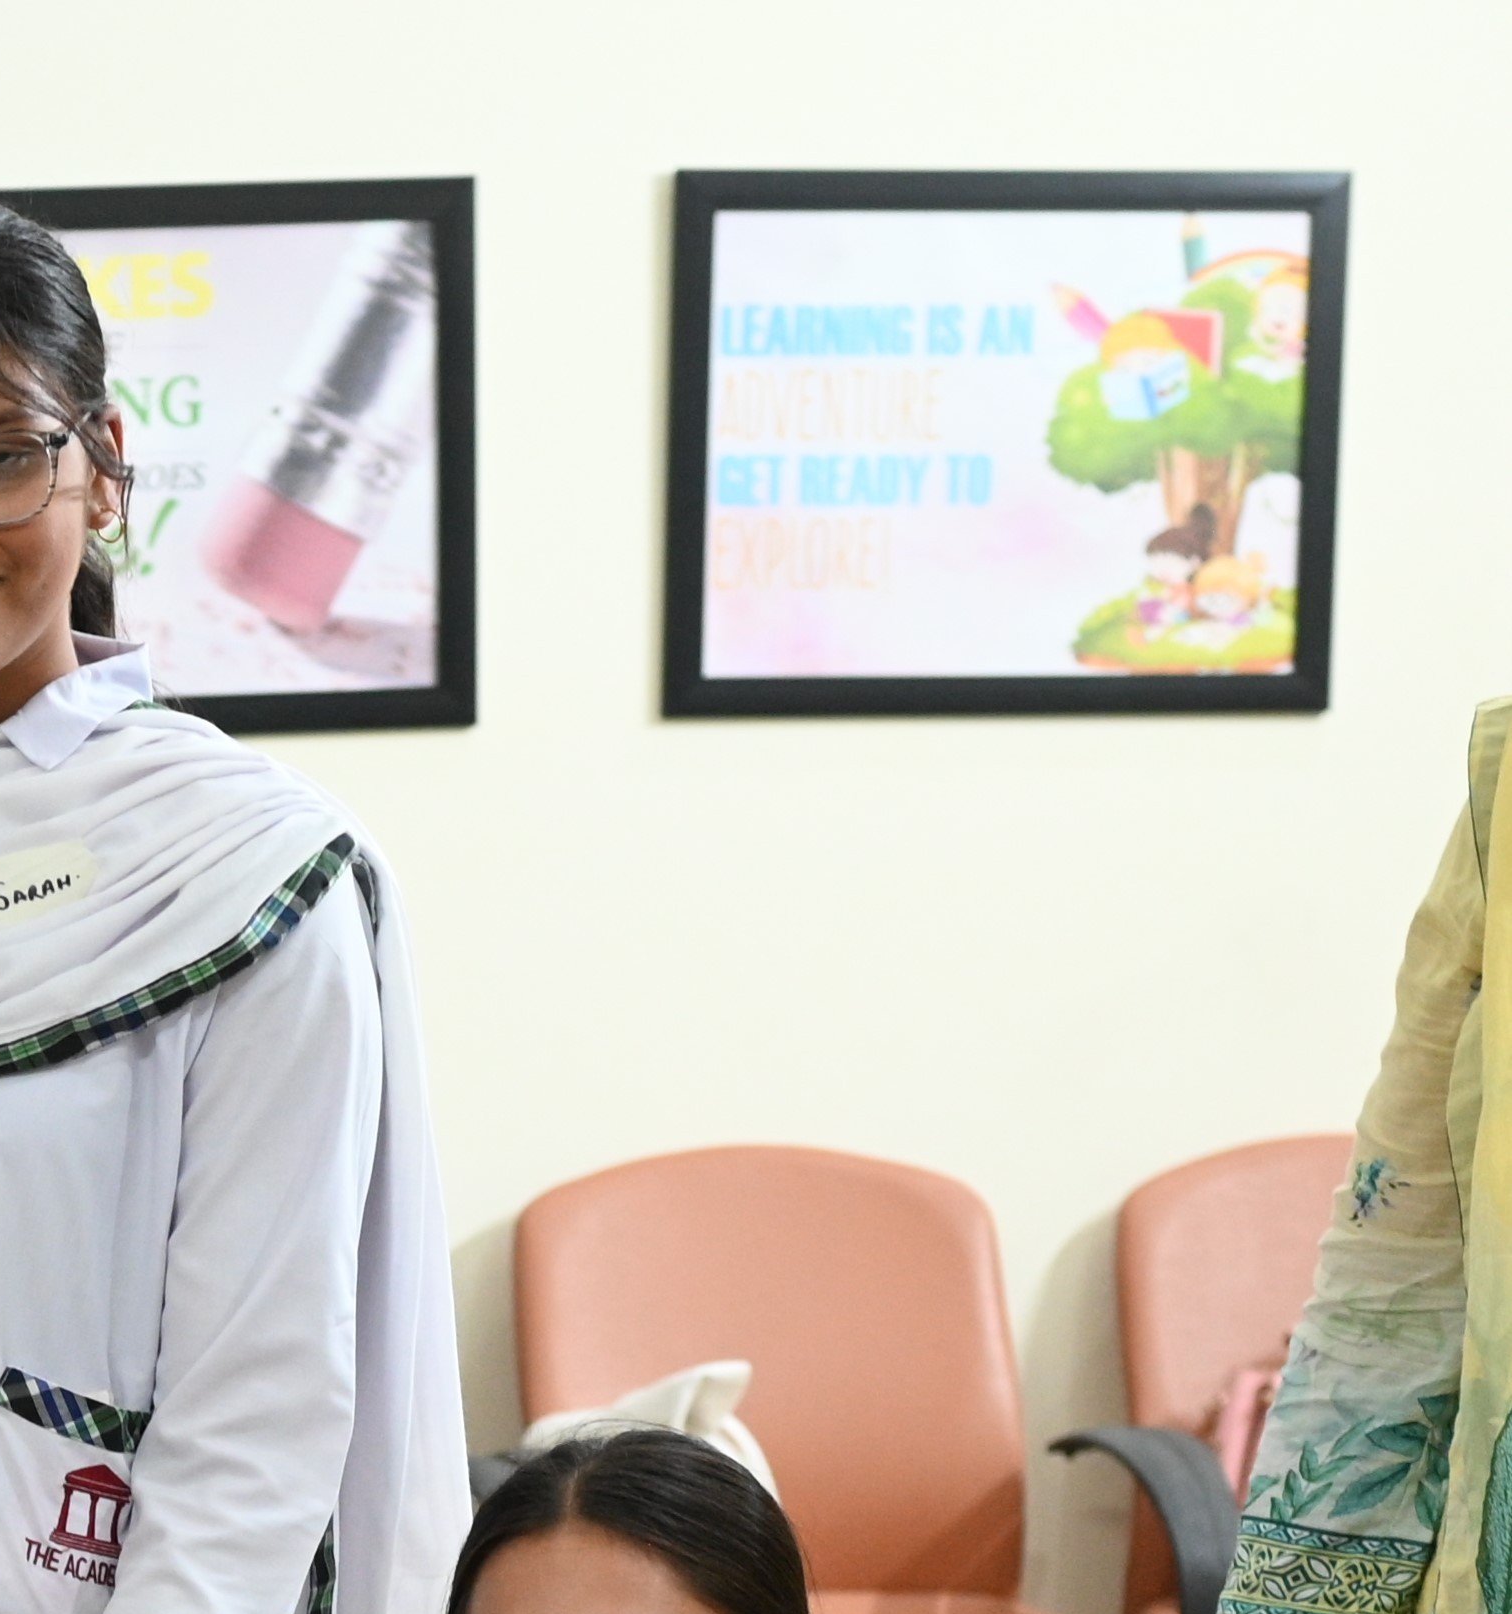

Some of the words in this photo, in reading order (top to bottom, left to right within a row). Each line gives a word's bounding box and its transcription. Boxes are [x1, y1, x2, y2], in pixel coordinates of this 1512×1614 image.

[720, 303, 914, 356] LEARNING
[928, 303, 965, 356] IS
[977, 303, 1035, 356] AN
[718, 367, 944, 443] ADVENTURE
[716, 454, 783, 507] GET
[799, 454, 931, 507] READY
[945, 454, 994, 507] TO
[25, 1537, 63, 1573] THE
[63, 1553, 118, 1588] ACADE
